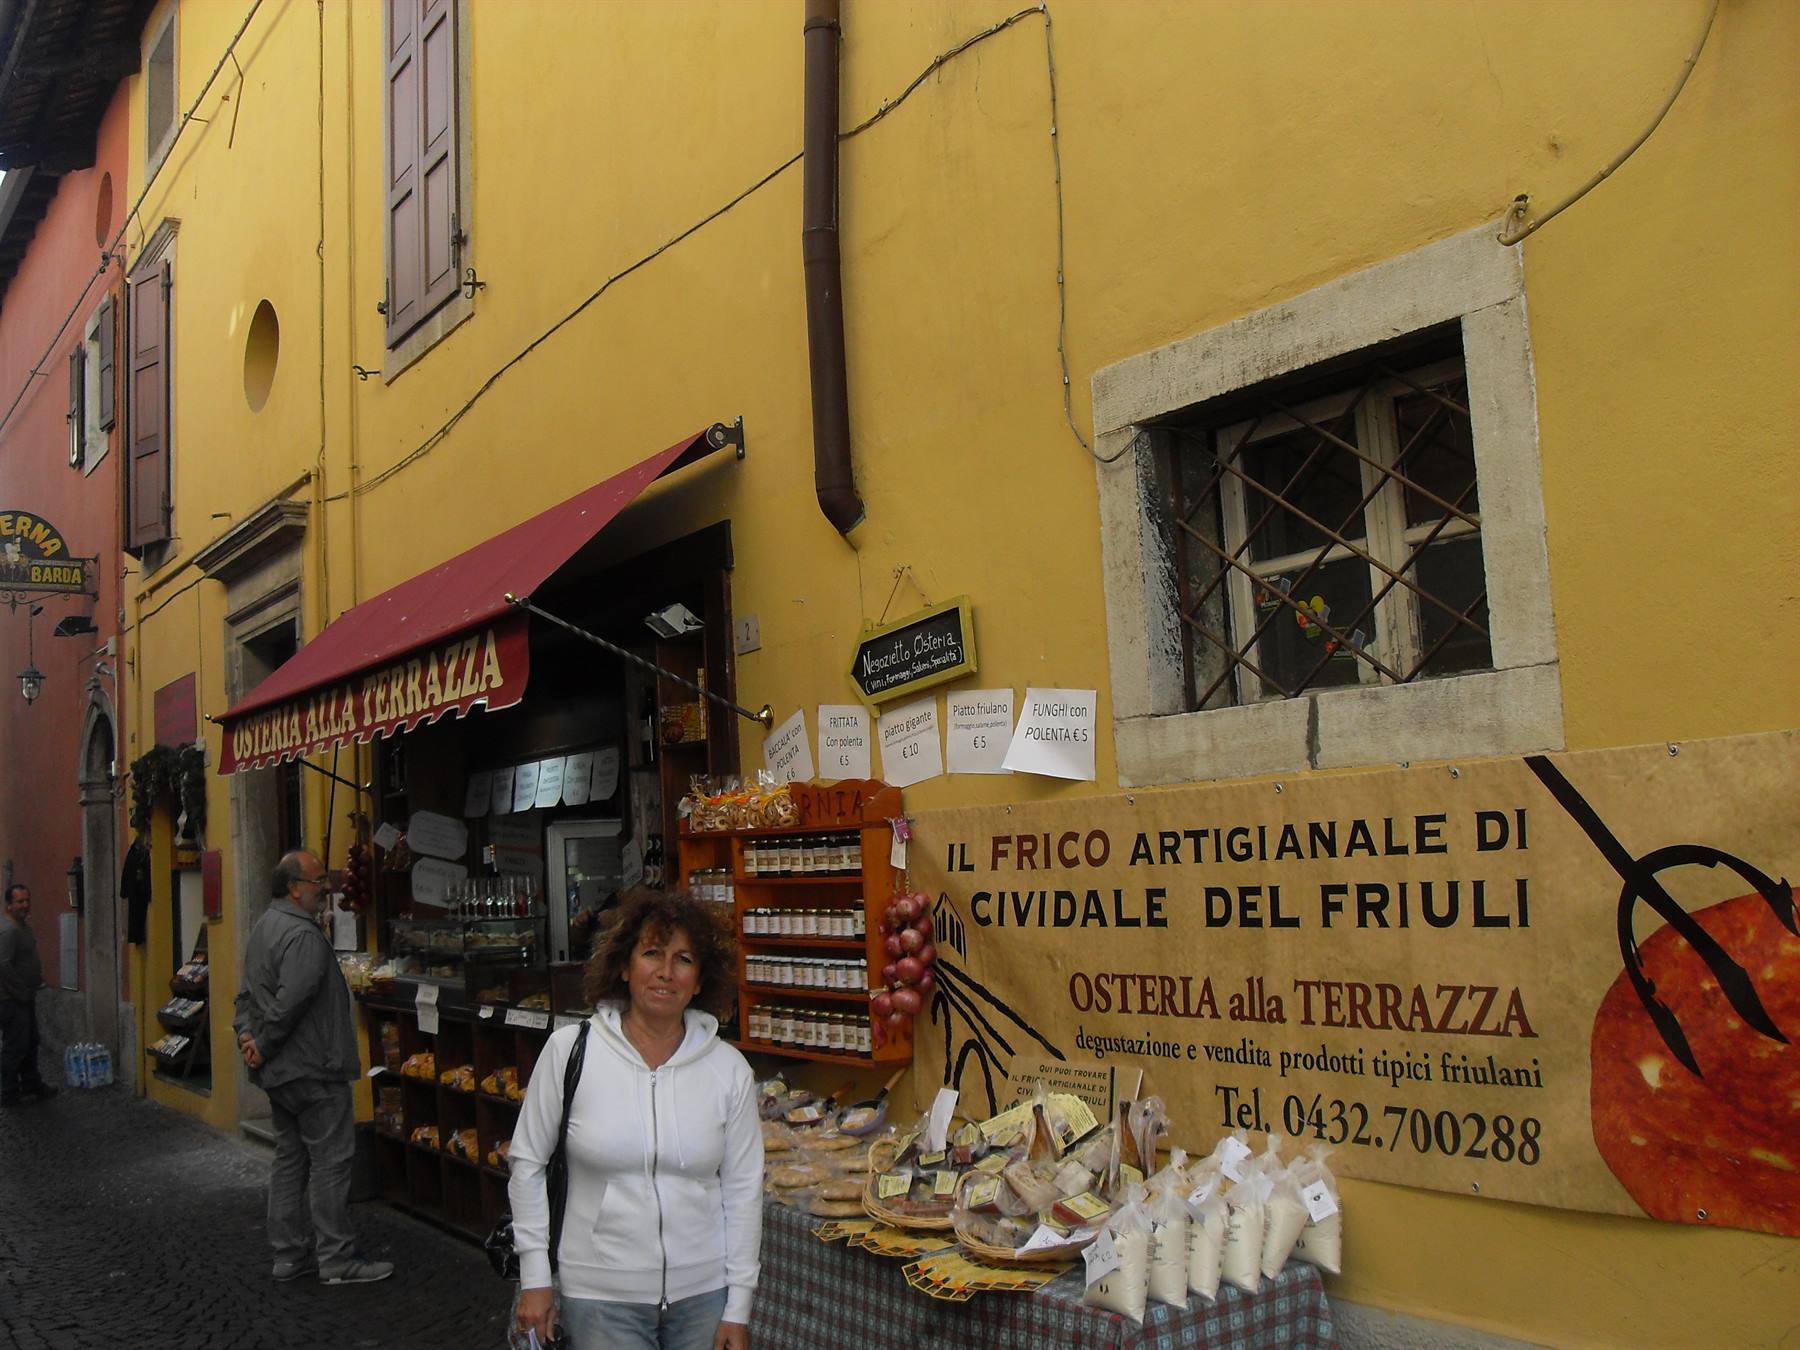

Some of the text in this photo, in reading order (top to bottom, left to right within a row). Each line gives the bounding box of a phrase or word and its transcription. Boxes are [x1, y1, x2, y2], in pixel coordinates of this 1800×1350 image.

[31, 565, 82, 584] BARDA
[744, 622, 751, 641] 2
[863, 631, 956, 677] Negozietto Osteria
[232, 628, 504, 761] OSTERIA ALLA TERRAZZA
[953, 702, 1008, 717] Piatto friulano
[1032, 703, 1087, 717] FUNGHI con
[829, 717, 859, 729] FRITTATA
[883, 723, 905, 742] piatto
[905, 710, 932, 733] gigante
[825, 735, 863, 750] Con polenta
[973, 735, 987, 749] € 5
[1024, 726, 1088, 742] POLENTA € 5
[776, 744, 800, 772] POLENTA
[902, 742, 919, 759] € 10
[839, 755, 850, 767] € 5
[798, 789, 863, 818] RNIA
[947, 808, 1529, 873] IL FRICO ARTIGIANALE DI
[970, 878, 1531, 929] CIVIDALE DEL FRIULI
[1068, 972, 1539, 1038] OSTERIA alla TERRAZZA
[1075, 1025, 1545, 1089] degustazione e vendita prodotti tipici friulani
[1039, 1064, 1108, 1080] QUI PUOI TROVARE
[1020, 1074, 1046, 1085] FRIC
[1048, 1079, 1098, 1092] ARTIGIANALE
[1099, 1085, 1107, 1094] DI
[1214, 1084, 1542, 1166] Tel. 0432.700288
